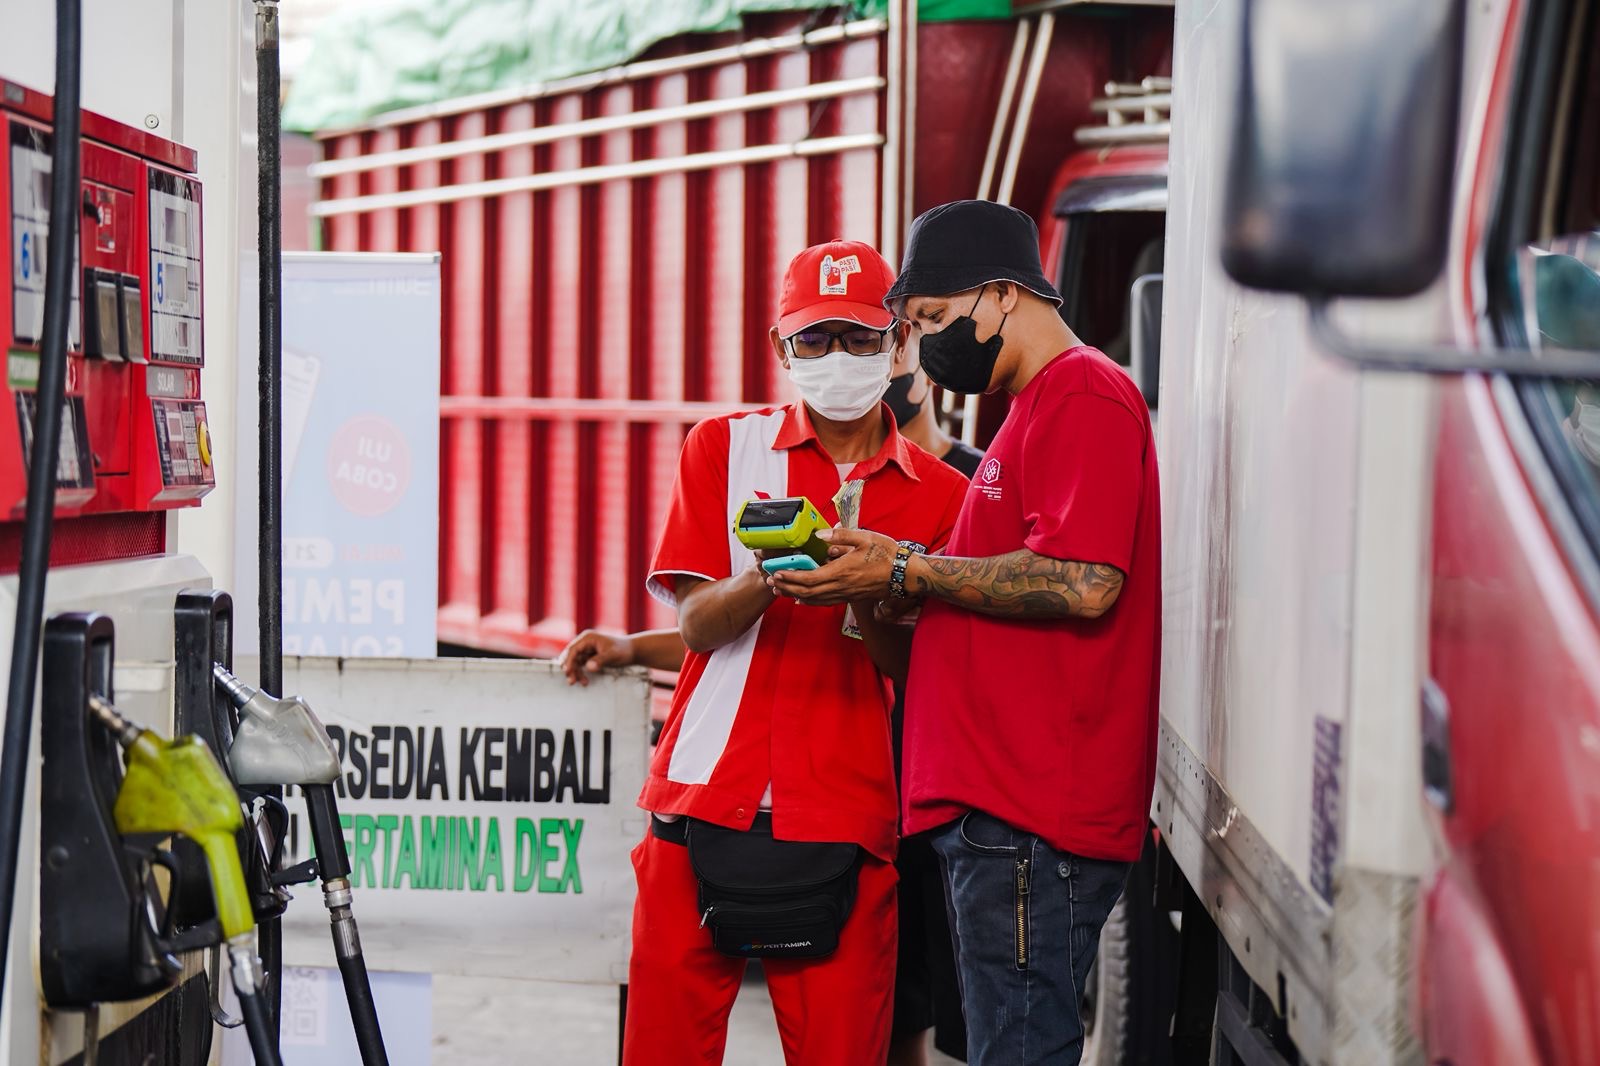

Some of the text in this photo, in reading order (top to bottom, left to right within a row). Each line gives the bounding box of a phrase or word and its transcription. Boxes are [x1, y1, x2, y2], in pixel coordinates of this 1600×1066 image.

[21, 232, 30, 281] 6
[157, 262, 164, 305] 5
[157, 373, 175, 392] SOLAR
[285, 725, 449, 800] RSEDIA
[459, 727, 611, 804] KEMBALI
[513, 817, 584, 894] DEX
[763, 941, 812, 949] PERTAMINA
